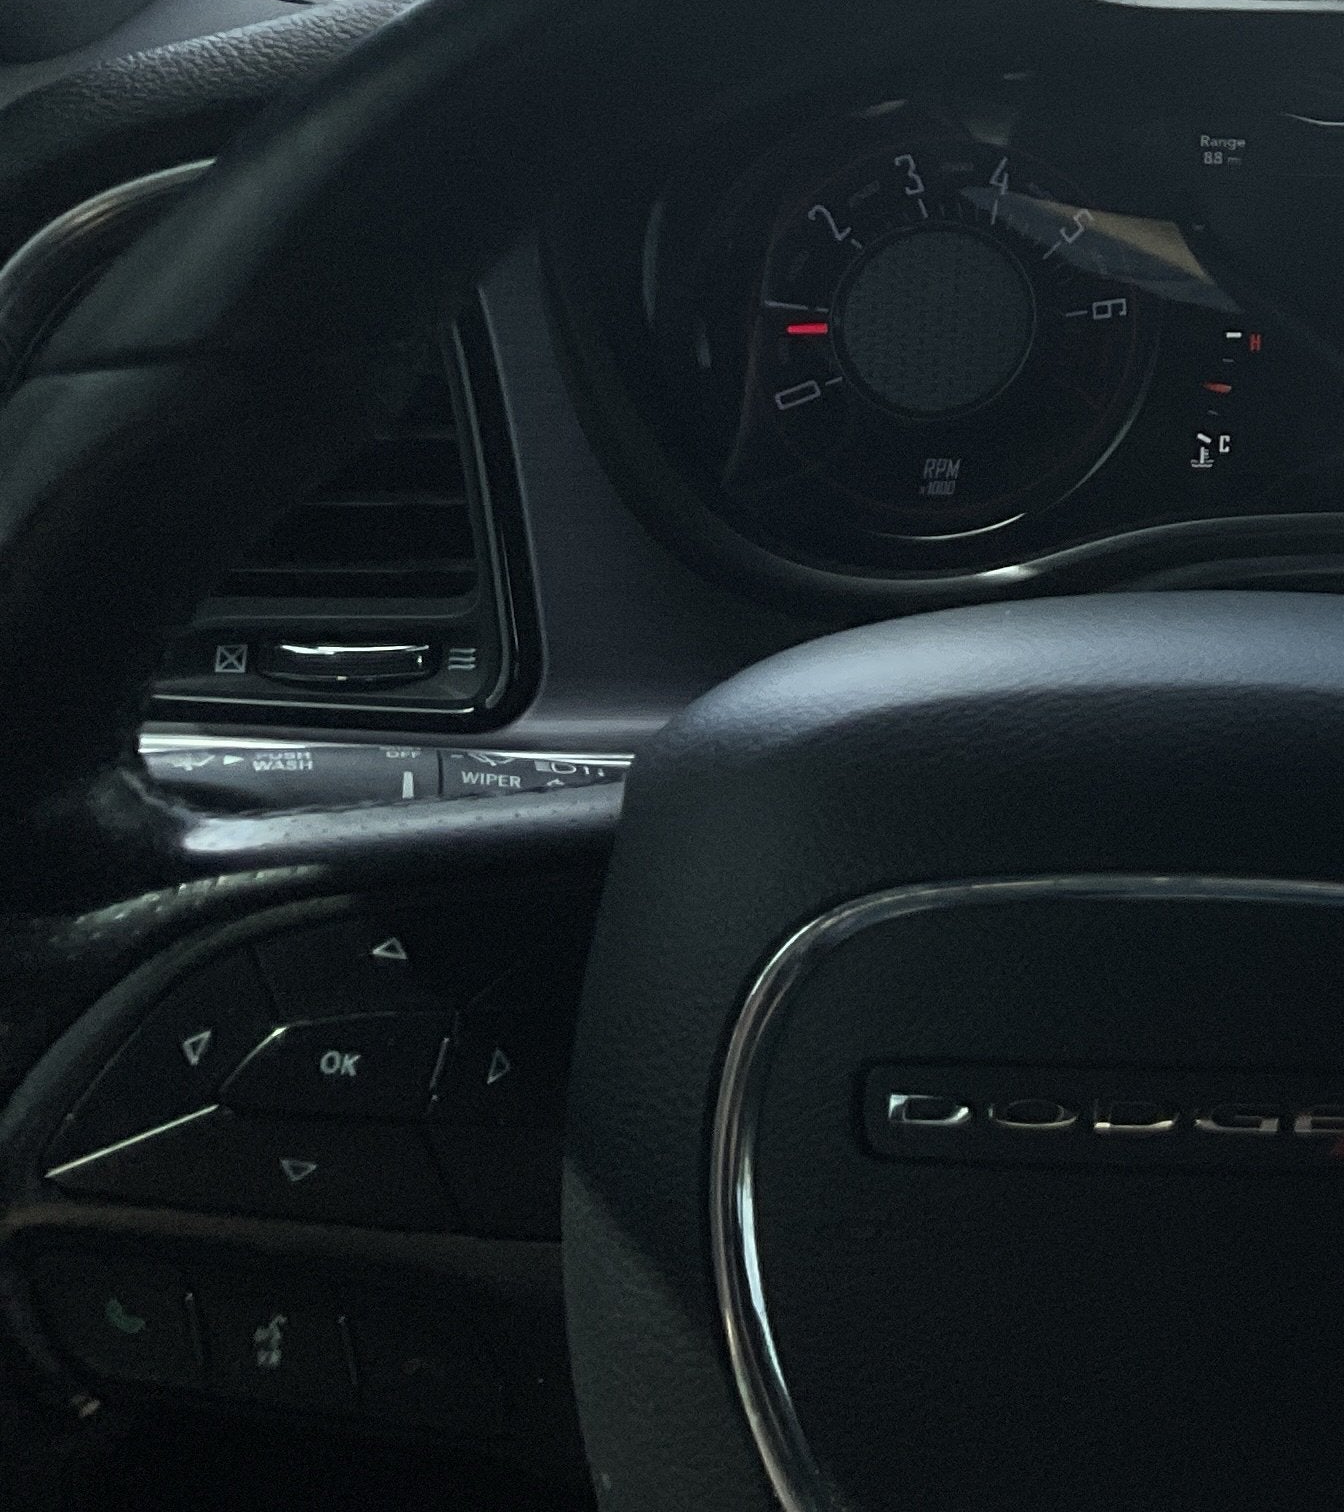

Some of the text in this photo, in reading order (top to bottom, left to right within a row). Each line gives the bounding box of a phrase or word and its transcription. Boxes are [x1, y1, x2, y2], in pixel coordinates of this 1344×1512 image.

[1200, 134, 1246, 151] Range
[895, 154, 925, 196] 3
[988, 156, 1009, 197] 4
[1248, 332, 1261, 351] H
[774, 380, 822, 410] 0
[1218, 435, 1231, 454] C
[923, 457, 962, 480] RPM
[252, 759, 313, 772] WASH
[461, 771, 522, 790] WIPER
[319, 1050, 362, 1077] OK
